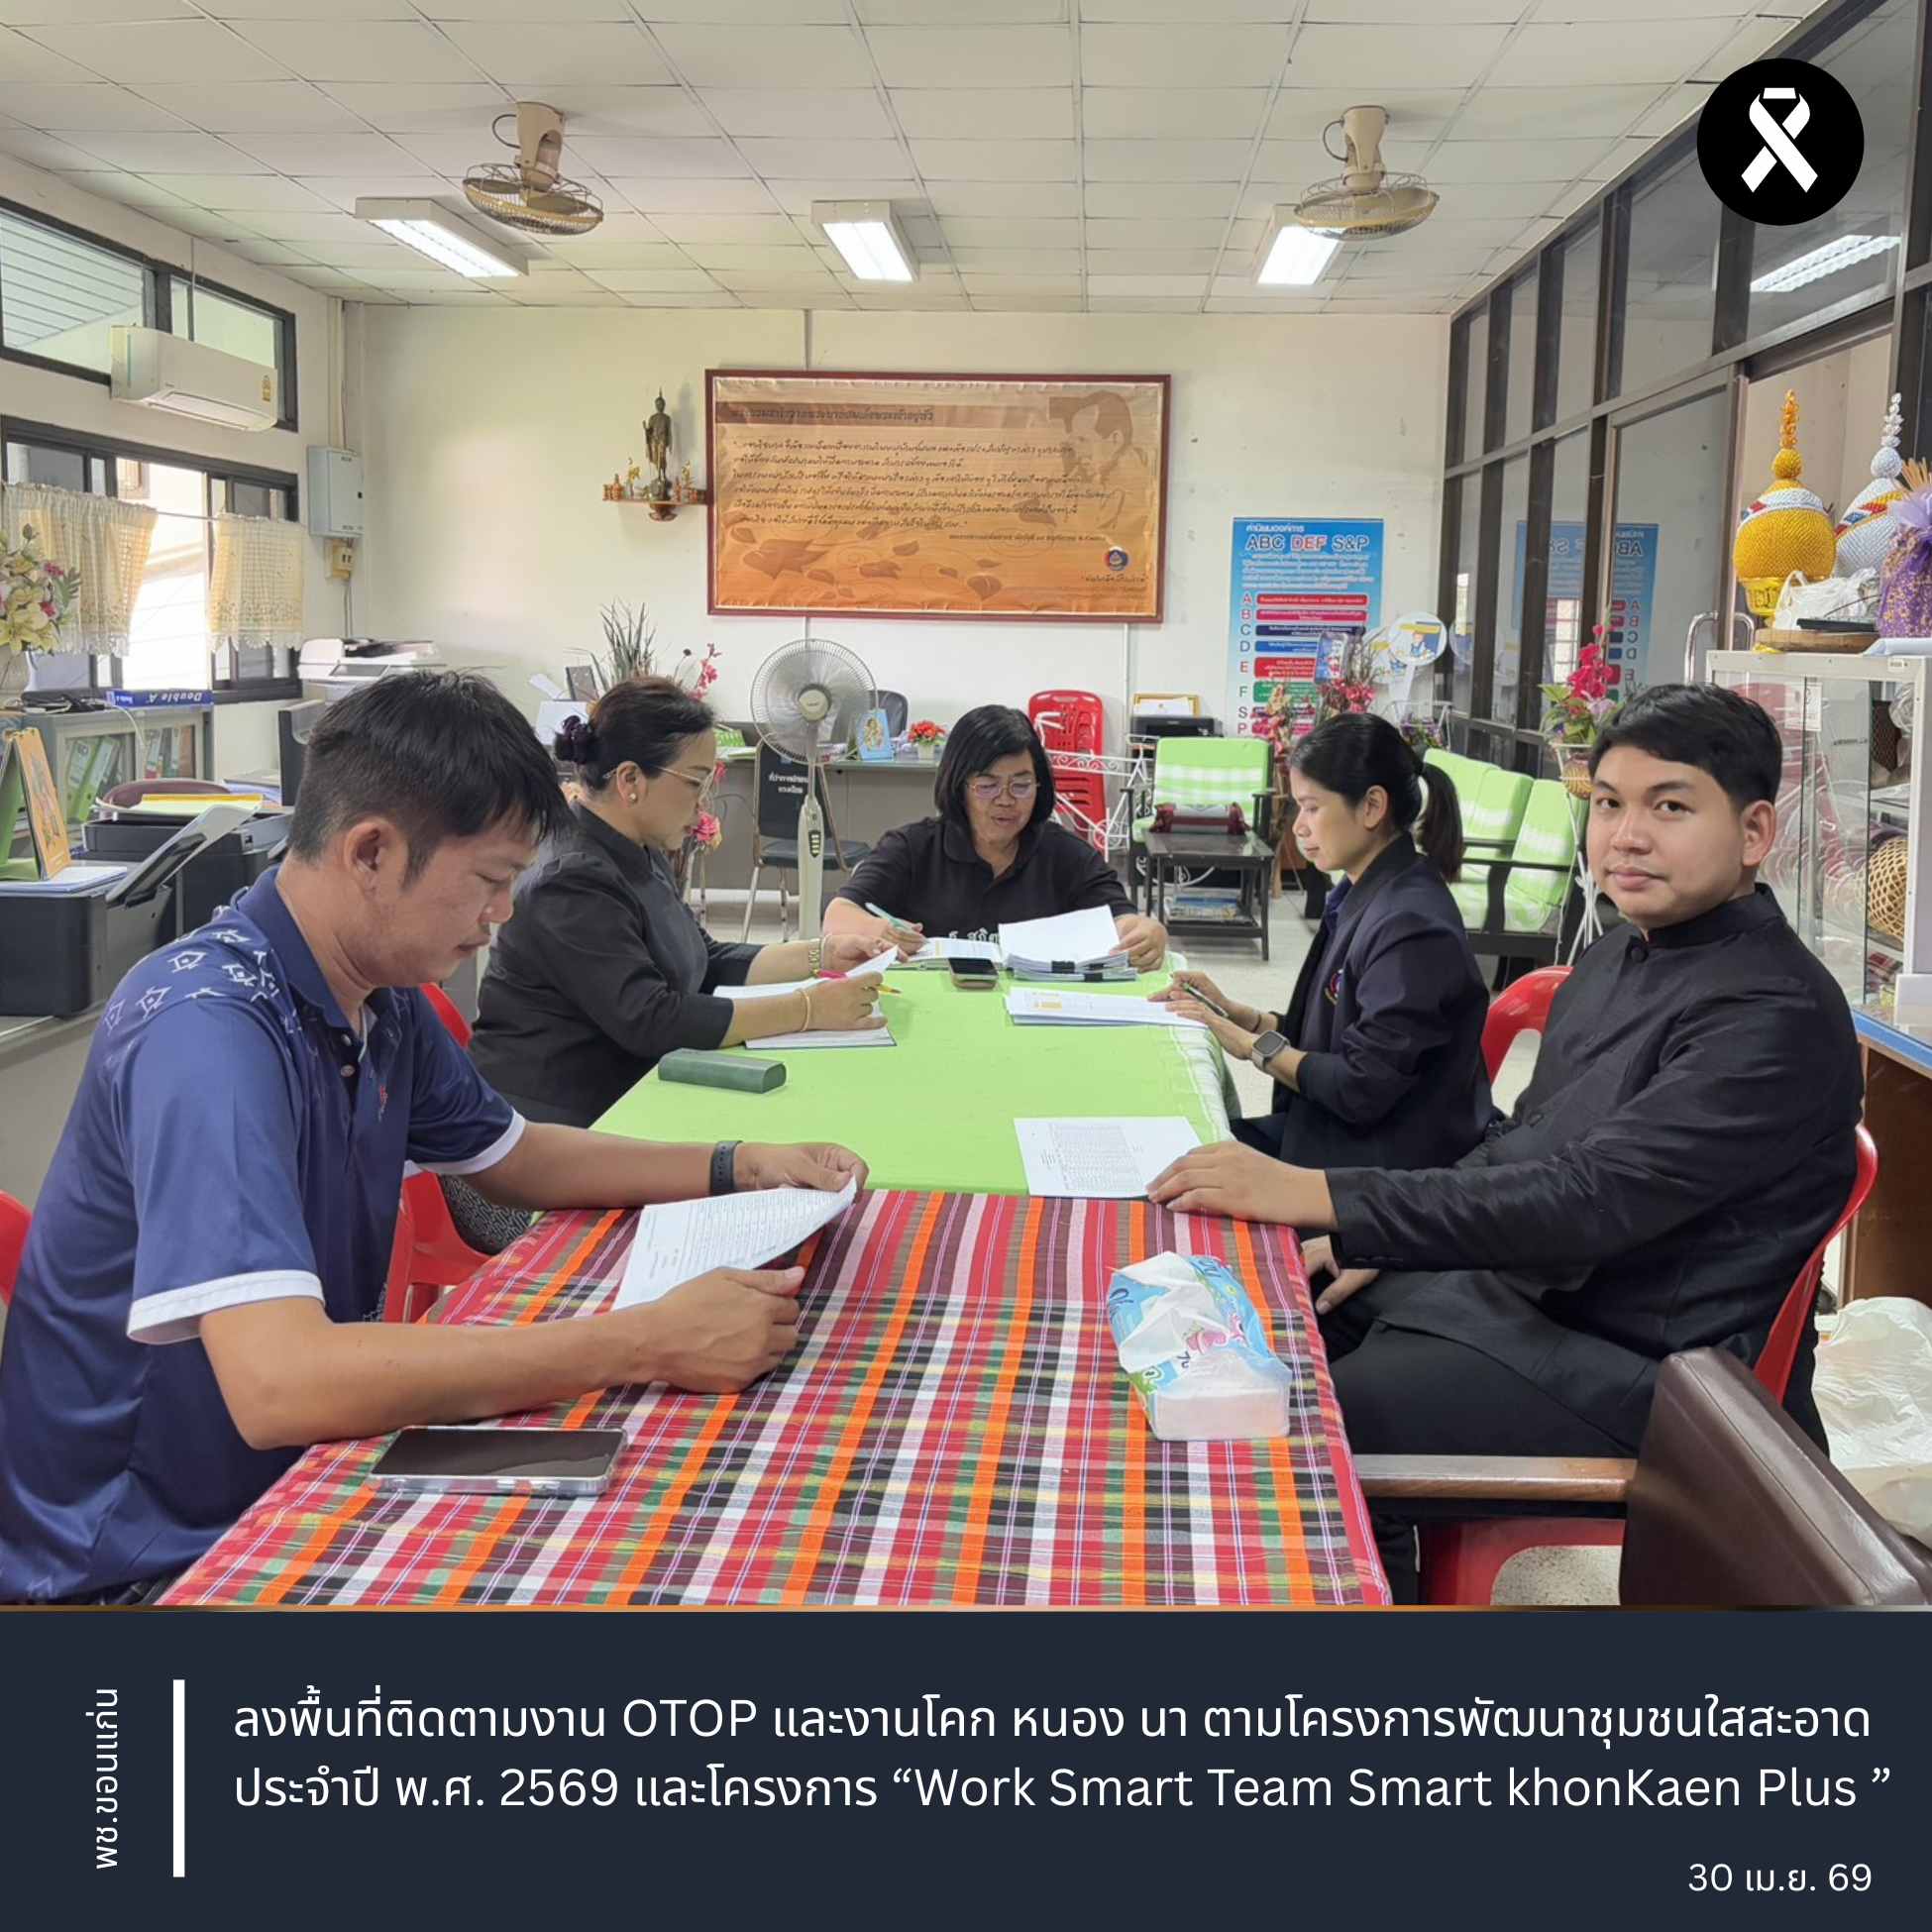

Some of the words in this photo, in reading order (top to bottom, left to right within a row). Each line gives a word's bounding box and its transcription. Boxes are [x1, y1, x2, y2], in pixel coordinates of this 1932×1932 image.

[1245, 533, 1285, 552] ABC
[1290, 534, 1328, 552] DEF
[1332, 535, 1369, 553] S&P
[1242, 593, 1252, 604] A
[1241, 608, 1252, 619] B
[1240, 624, 1251, 636] C
[1240, 641, 1250, 652] D
[1240, 661, 1248, 673] E
[161, 692, 202, 702] Double
[1239, 686, 1248, 698] F
[149, 693, 159, 703] A
[1238, 706, 1248, 719] S
[1237, 723, 1247, 734] P
